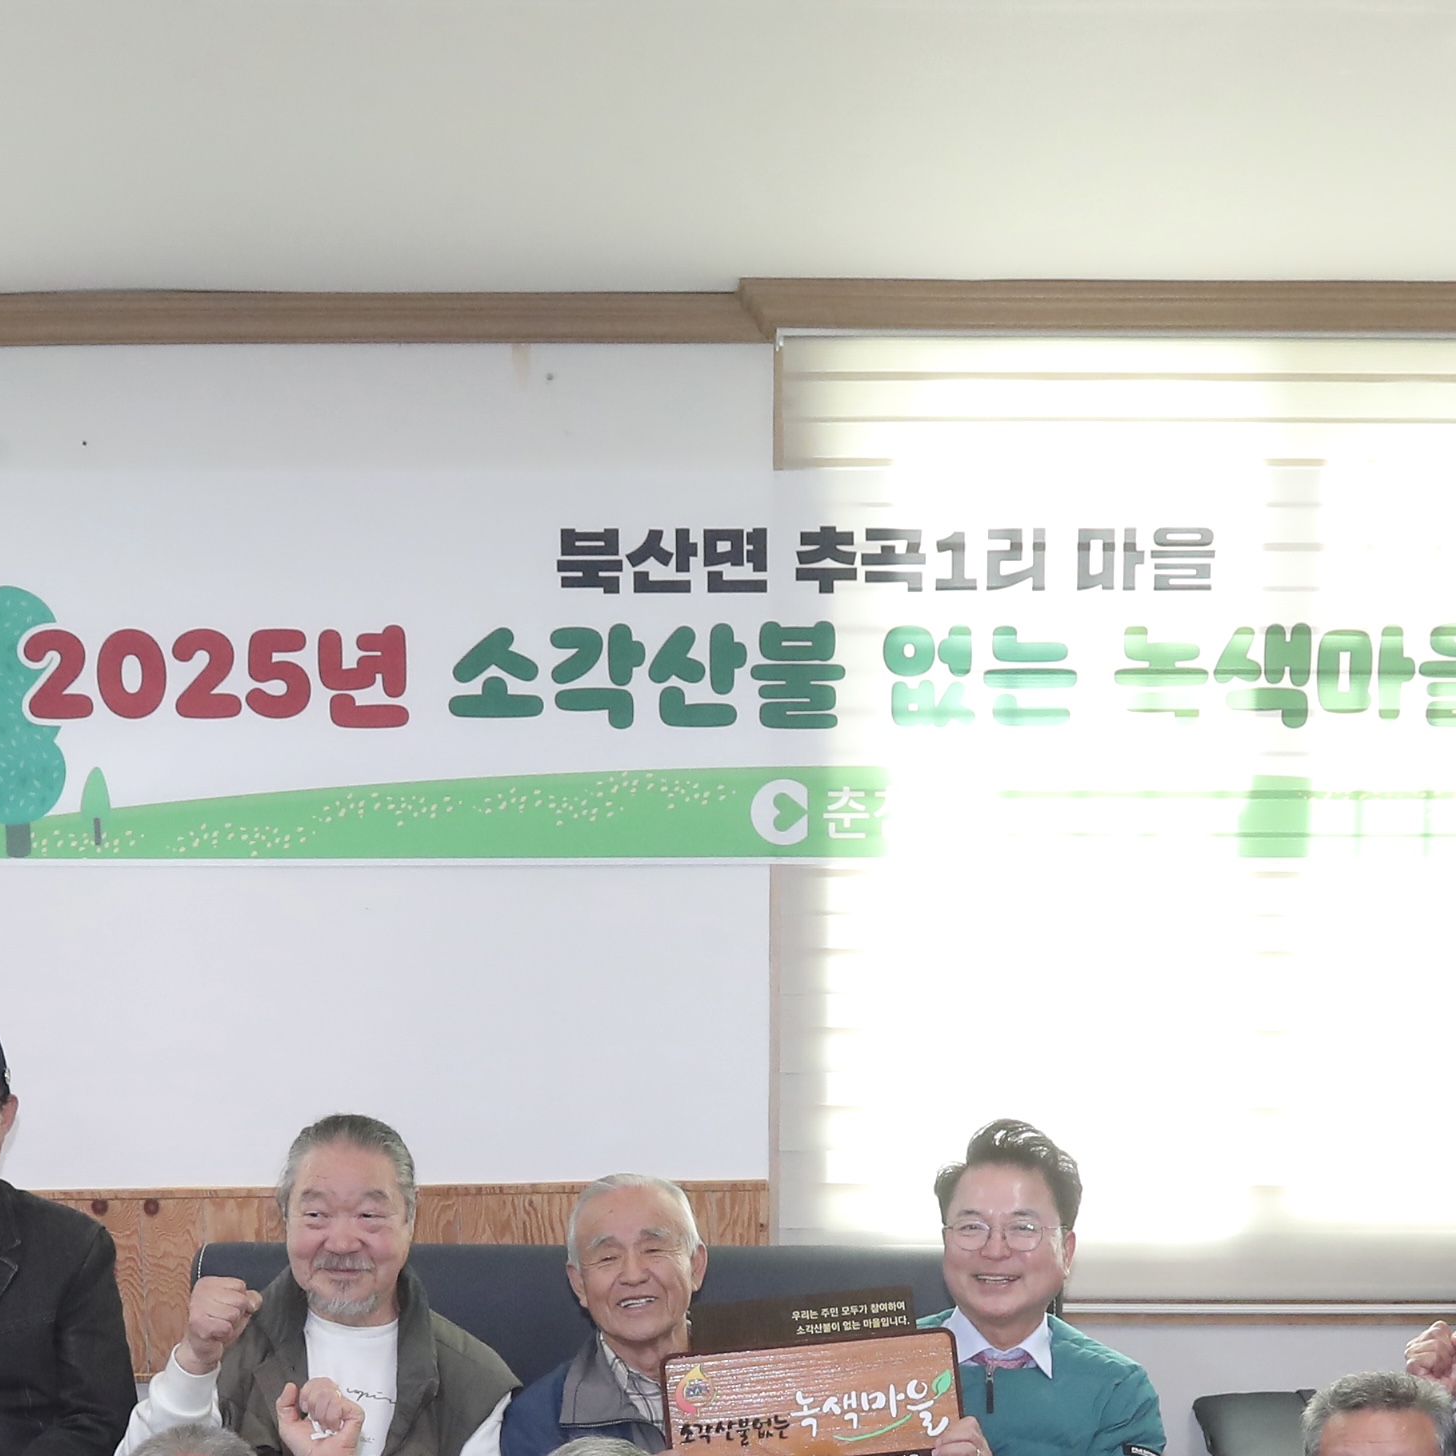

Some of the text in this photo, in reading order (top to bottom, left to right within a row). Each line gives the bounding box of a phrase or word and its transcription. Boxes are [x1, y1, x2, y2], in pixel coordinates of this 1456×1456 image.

[555, 525, 1217, 595] 북산면 추곡1리 마을
[22, 624, 410, 729] 2025년
[447, 620, 847, 730] 소각산불
[882, 625, 1078, 729] 없는
[791, 1300, 905, 1321] 우리는 주민 모두가 참여하여
[796, 1316, 910, 1335] 소각산불이 없는 마을입니다.
[790, 1377, 951, 1437] 녹색마을
